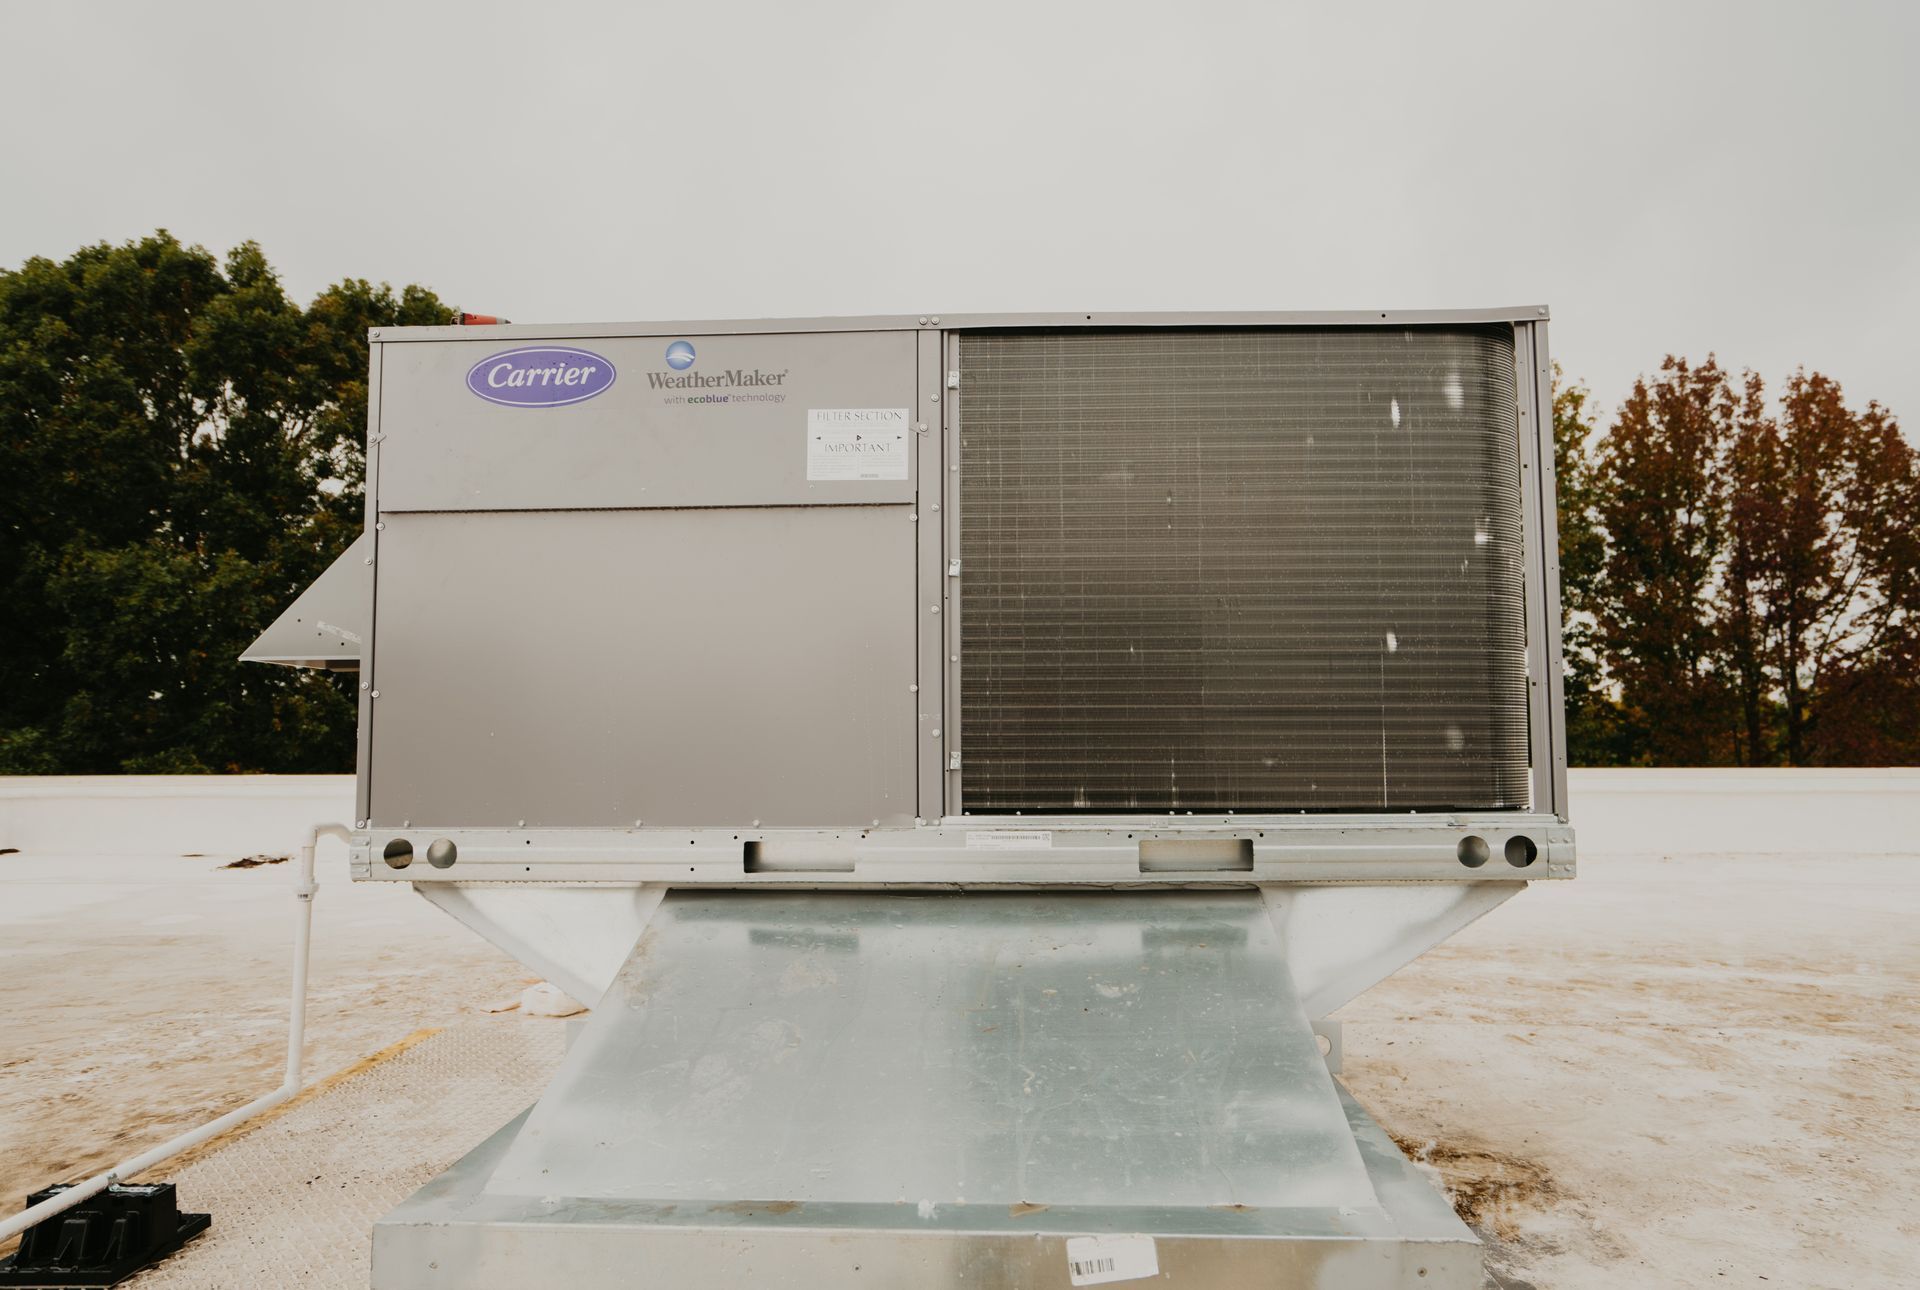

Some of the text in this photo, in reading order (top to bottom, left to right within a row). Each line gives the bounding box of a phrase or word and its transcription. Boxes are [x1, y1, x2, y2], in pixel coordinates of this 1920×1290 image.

[487, 363, 597, 388] Carrier
[663, 394, 687, 405] with
[732, 392, 787, 403] technology
[816, 410, 903, 421] FILTER SECTION
[824, 443, 891, 453] IMPORTANT
